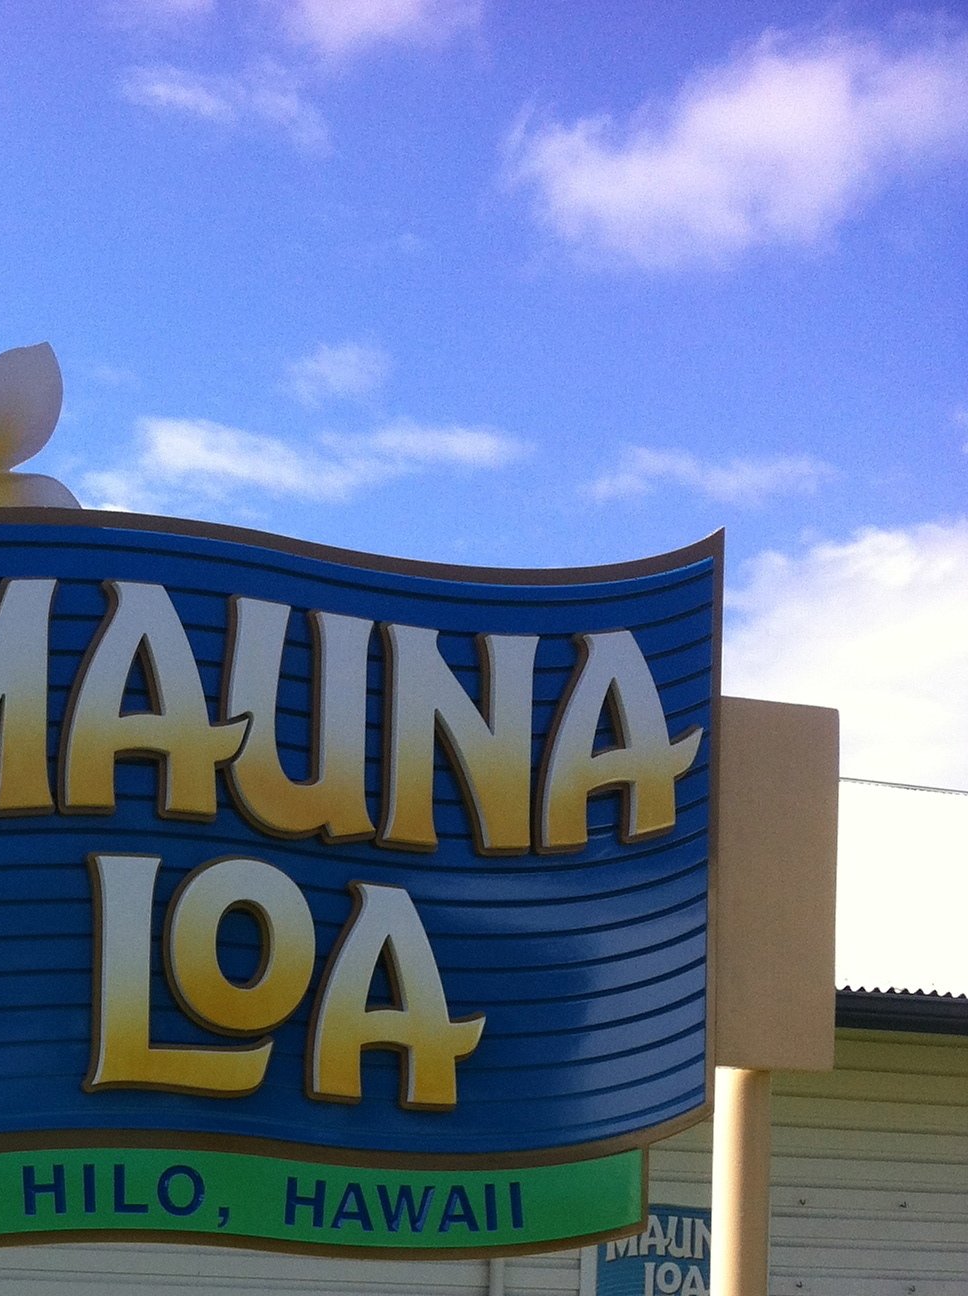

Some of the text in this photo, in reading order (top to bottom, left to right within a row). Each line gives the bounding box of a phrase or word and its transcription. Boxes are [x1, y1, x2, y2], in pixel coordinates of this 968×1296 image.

[84, 853, 486, 1111] LOA
[22, 1163, 525, 1233] HILO, HAWAII
[605, 1214, 711, 1262] AUN
